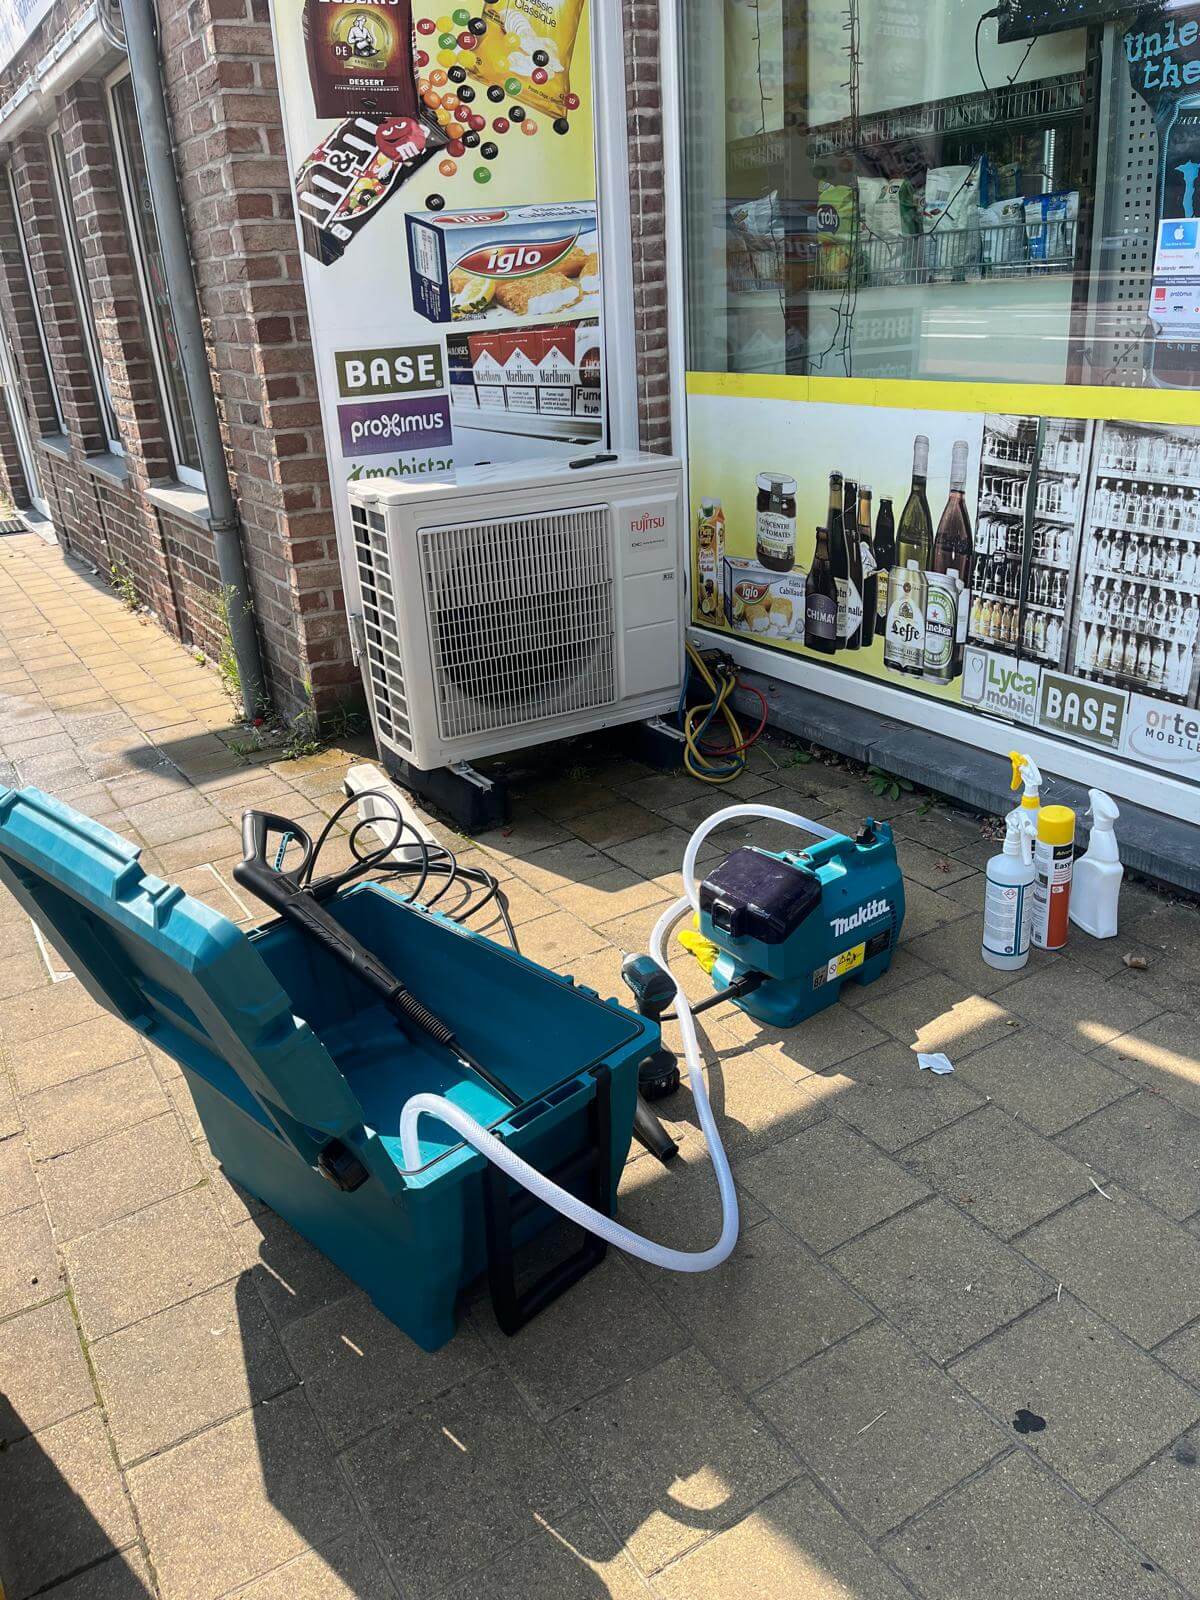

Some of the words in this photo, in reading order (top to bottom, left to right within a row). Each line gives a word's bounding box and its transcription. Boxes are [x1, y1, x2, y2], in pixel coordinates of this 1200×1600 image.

[515, 1, 557, 27] Classique
[335, 46, 349, 56] DE
[1124, 20, 1200, 62] Unle
[349, 78, 385, 86] DESSERT
[1143, 56, 1200, 91] the
[454, 214, 491, 224] iglo
[488, 247, 542, 273] iglo
[345, 354, 436, 388] BASE
[505, 370, 535, 384] Marlboro
[539, 370, 571, 384] Marlboro
[577, 389, 601, 400] Fume
[584, 403, 600, 414] tue
[351, 412, 444, 443] proximus
[631, 516, 665, 533] FUJITSU
[742, 585, 759, 600] iglo
[806, 607, 836, 625] CHIMAY
[891, 619, 920, 642] Leffe
[926, 621, 952, 636] ineken
[988, 659, 1037, 697] Lyca
[986, 690, 1034, 717] mobile
[1046, 687, 1117, 738] BASE
[1146, 710, 1200, 740] orte
